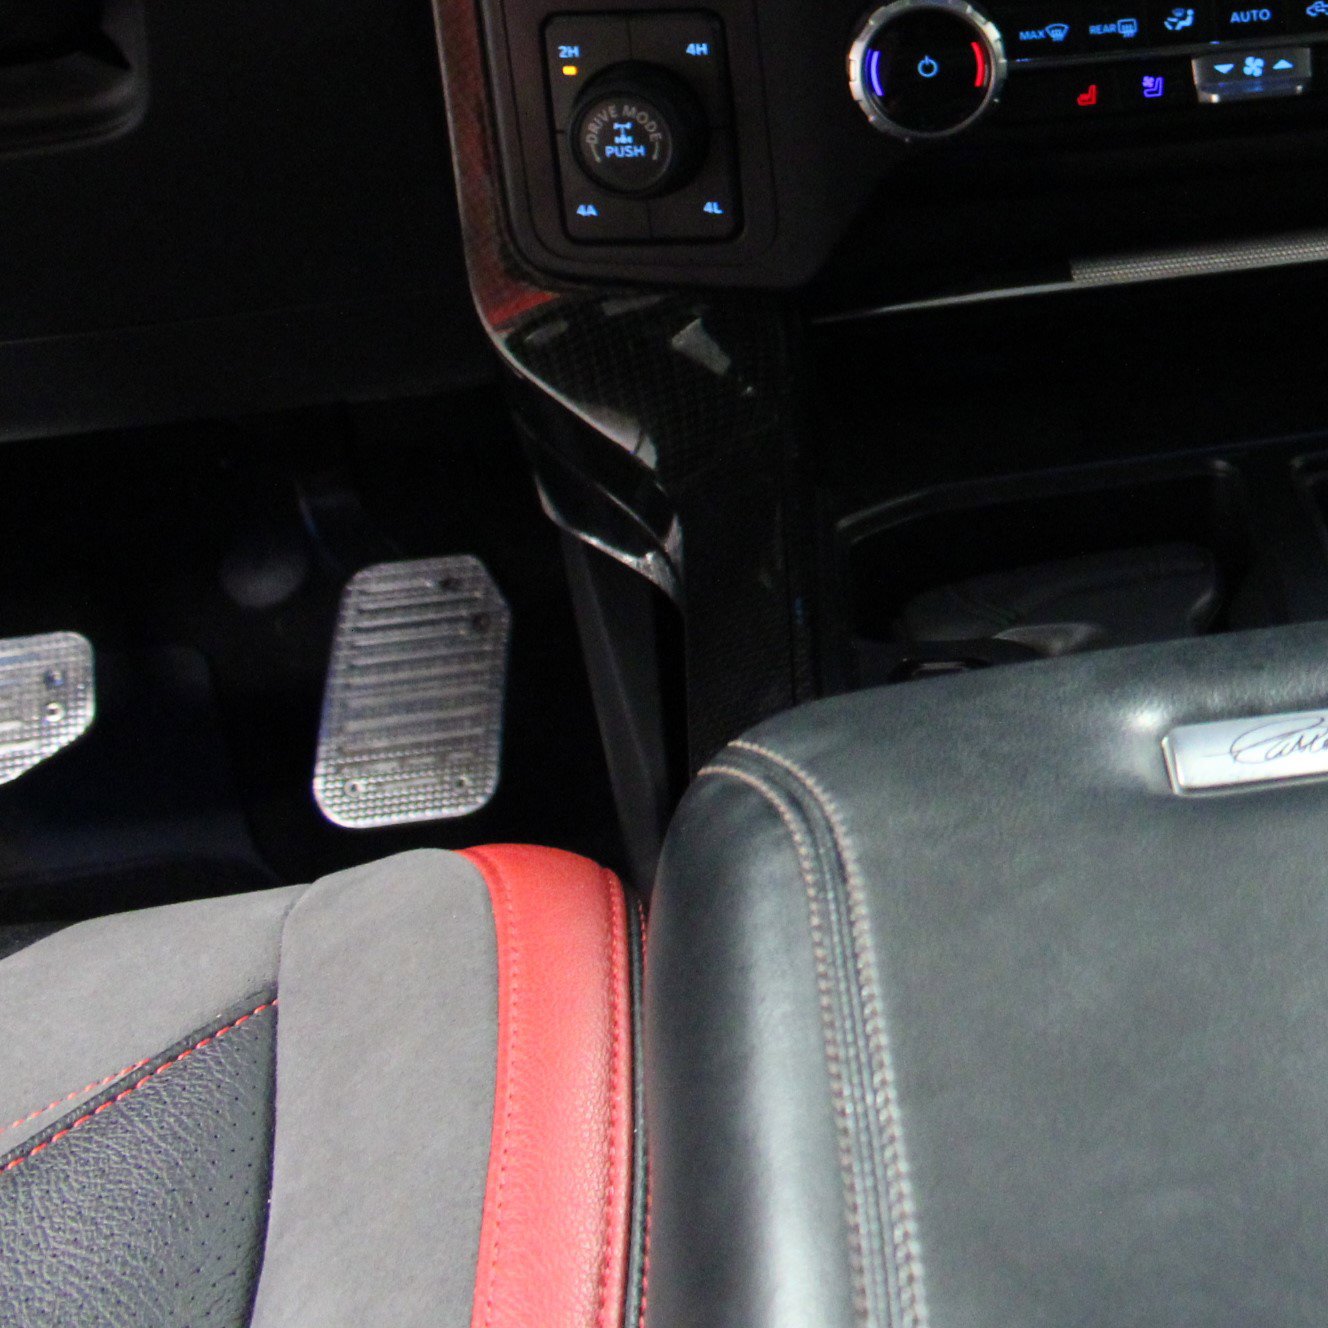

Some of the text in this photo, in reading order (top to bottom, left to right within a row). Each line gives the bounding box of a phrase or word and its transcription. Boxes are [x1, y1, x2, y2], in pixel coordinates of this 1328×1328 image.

[1230, 8, 1271, 23] AUTO
[1019, 28, 1045, 41] MAX
[1089, 23, 1117, 35] REAR
[558, 45, 580, 58] 2H
[686, 43, 710, 56] 4H
[586, 104, 662, 145] DRIVE MODE
[605, 145, 646, 158] PUSH
[576, 204, 598, 217] 4A
[703, 201, 724, 214] 4L
